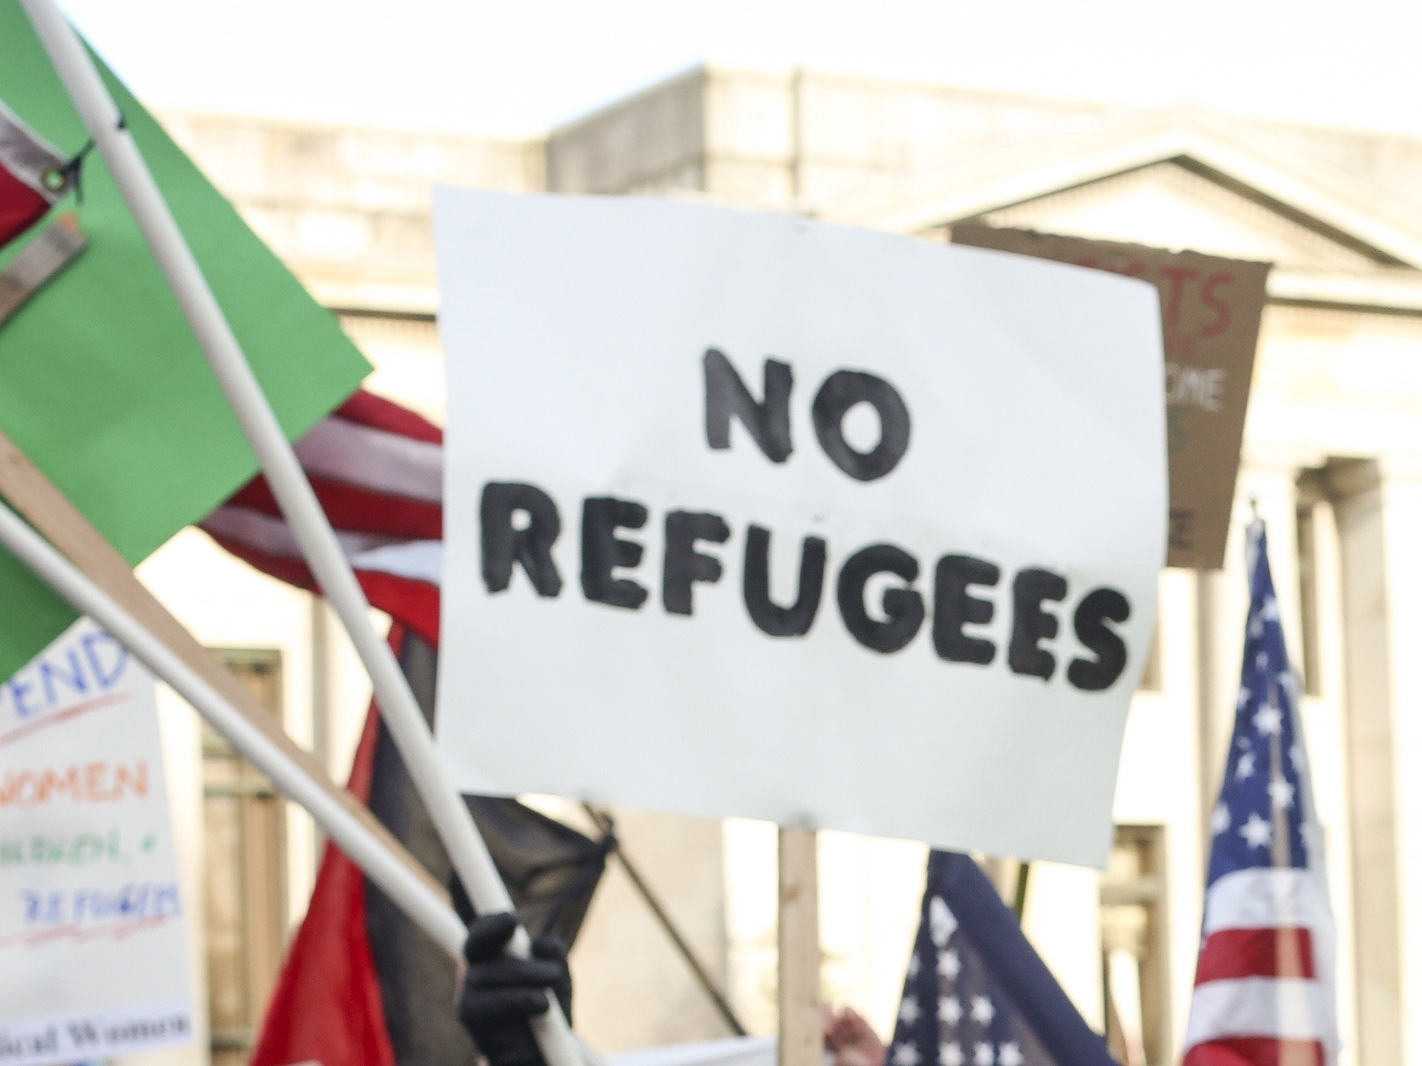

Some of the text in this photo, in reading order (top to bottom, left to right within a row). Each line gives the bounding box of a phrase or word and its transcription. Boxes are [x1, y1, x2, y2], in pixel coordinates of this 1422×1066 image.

[703, 348, 911, 483] NO
[479, 480, 1132, 693] REFUGEES
[67, 1014, 191, 1047] Women
